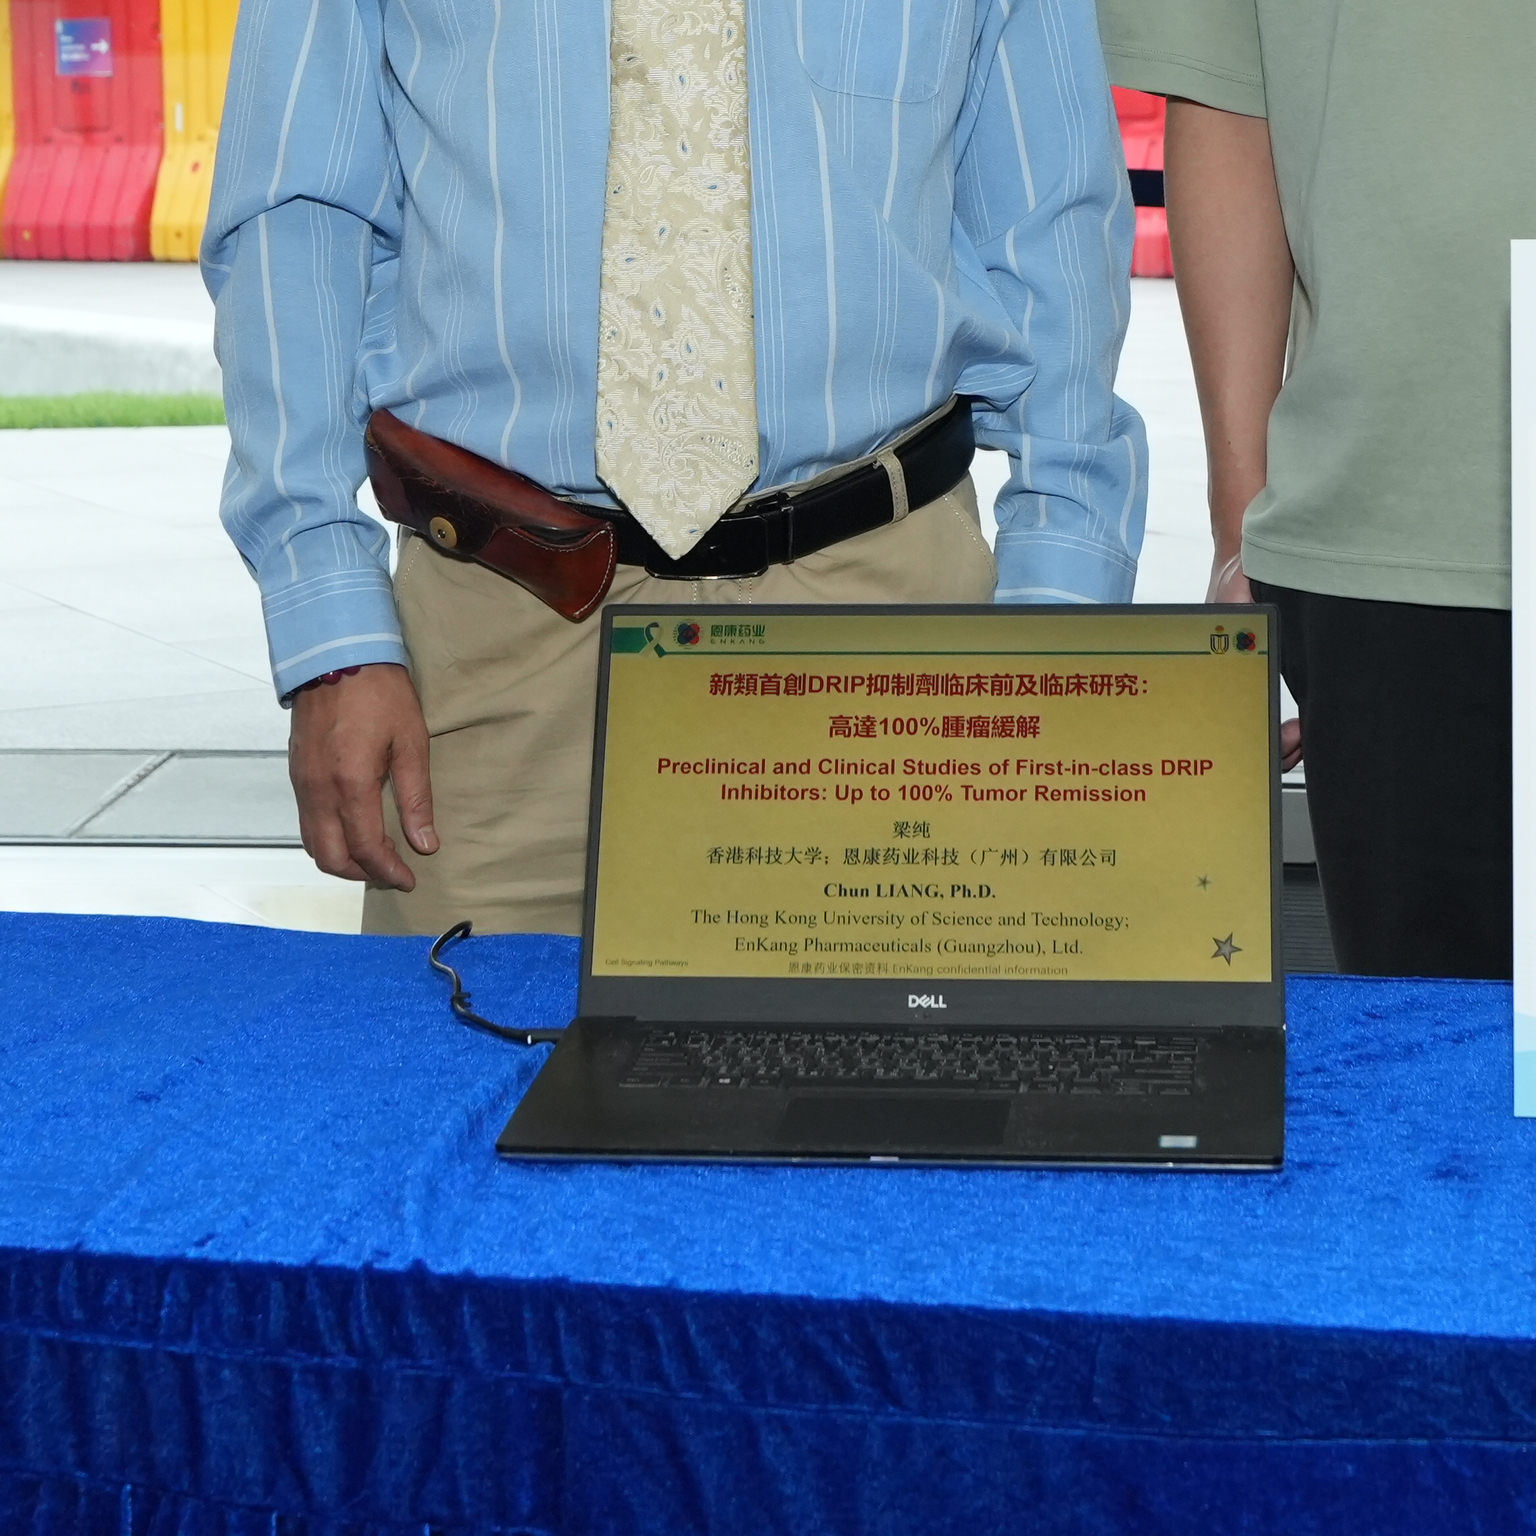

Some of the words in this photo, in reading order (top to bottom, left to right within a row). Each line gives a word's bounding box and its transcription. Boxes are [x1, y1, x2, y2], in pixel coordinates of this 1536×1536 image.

[829, 714, 1040, 739] 高達100%腫瘤緩解
[658, 758, 765, 775] Preclinical
[773, 759, 810, 775] and
[819, 758, 895, 776] Clinical
[903, 759, 981, 776] Studies
[989, 759, 1009, 775] of
[1017, 759, 1153, 776] First-in-class
[1162, 759, 1213, 776] DRIP
[722, 784, 826, 801] Inhibitors:
[836, 784, 863, 805] Up
[870, 785, 890, 801] to
[899, 784, 952, 802] 100%
[961, 785, 1027, 801] Tumor
[1035, 785, 1145, 802] Remission
[893, 820, 930, 840] 梁纯
[824, 884, 869, 898] Chun
[877, 884, 943, 899] LIANG,
[951, 884, 995, 898] Ph.D.
[691, 909, 720, 924] The
[727, 910, 768, 928] Hong
[776, 910, 817, 929] Kong
[824, 910, 904, 929] University
[911, 911, 928, 925] of
[933, 911, 992, 926] Science
[999, 912, 1025, 926] and
[1032, 912, 1128, 931] Technology;
[736, 937, 797, 956] EnKang
[805, 937, 931, 953] Pharmaceuticals
[938, 939, 1045, 957] (Guangzhou),
[1053, 939, 1082, 954] Ltd.
[893, 963, 933, 975] EnKang
[937, 964, 1000, 974] confidential
[1005, 964, 1067, 975] information
[908, 994, 947, 1008] DELL
